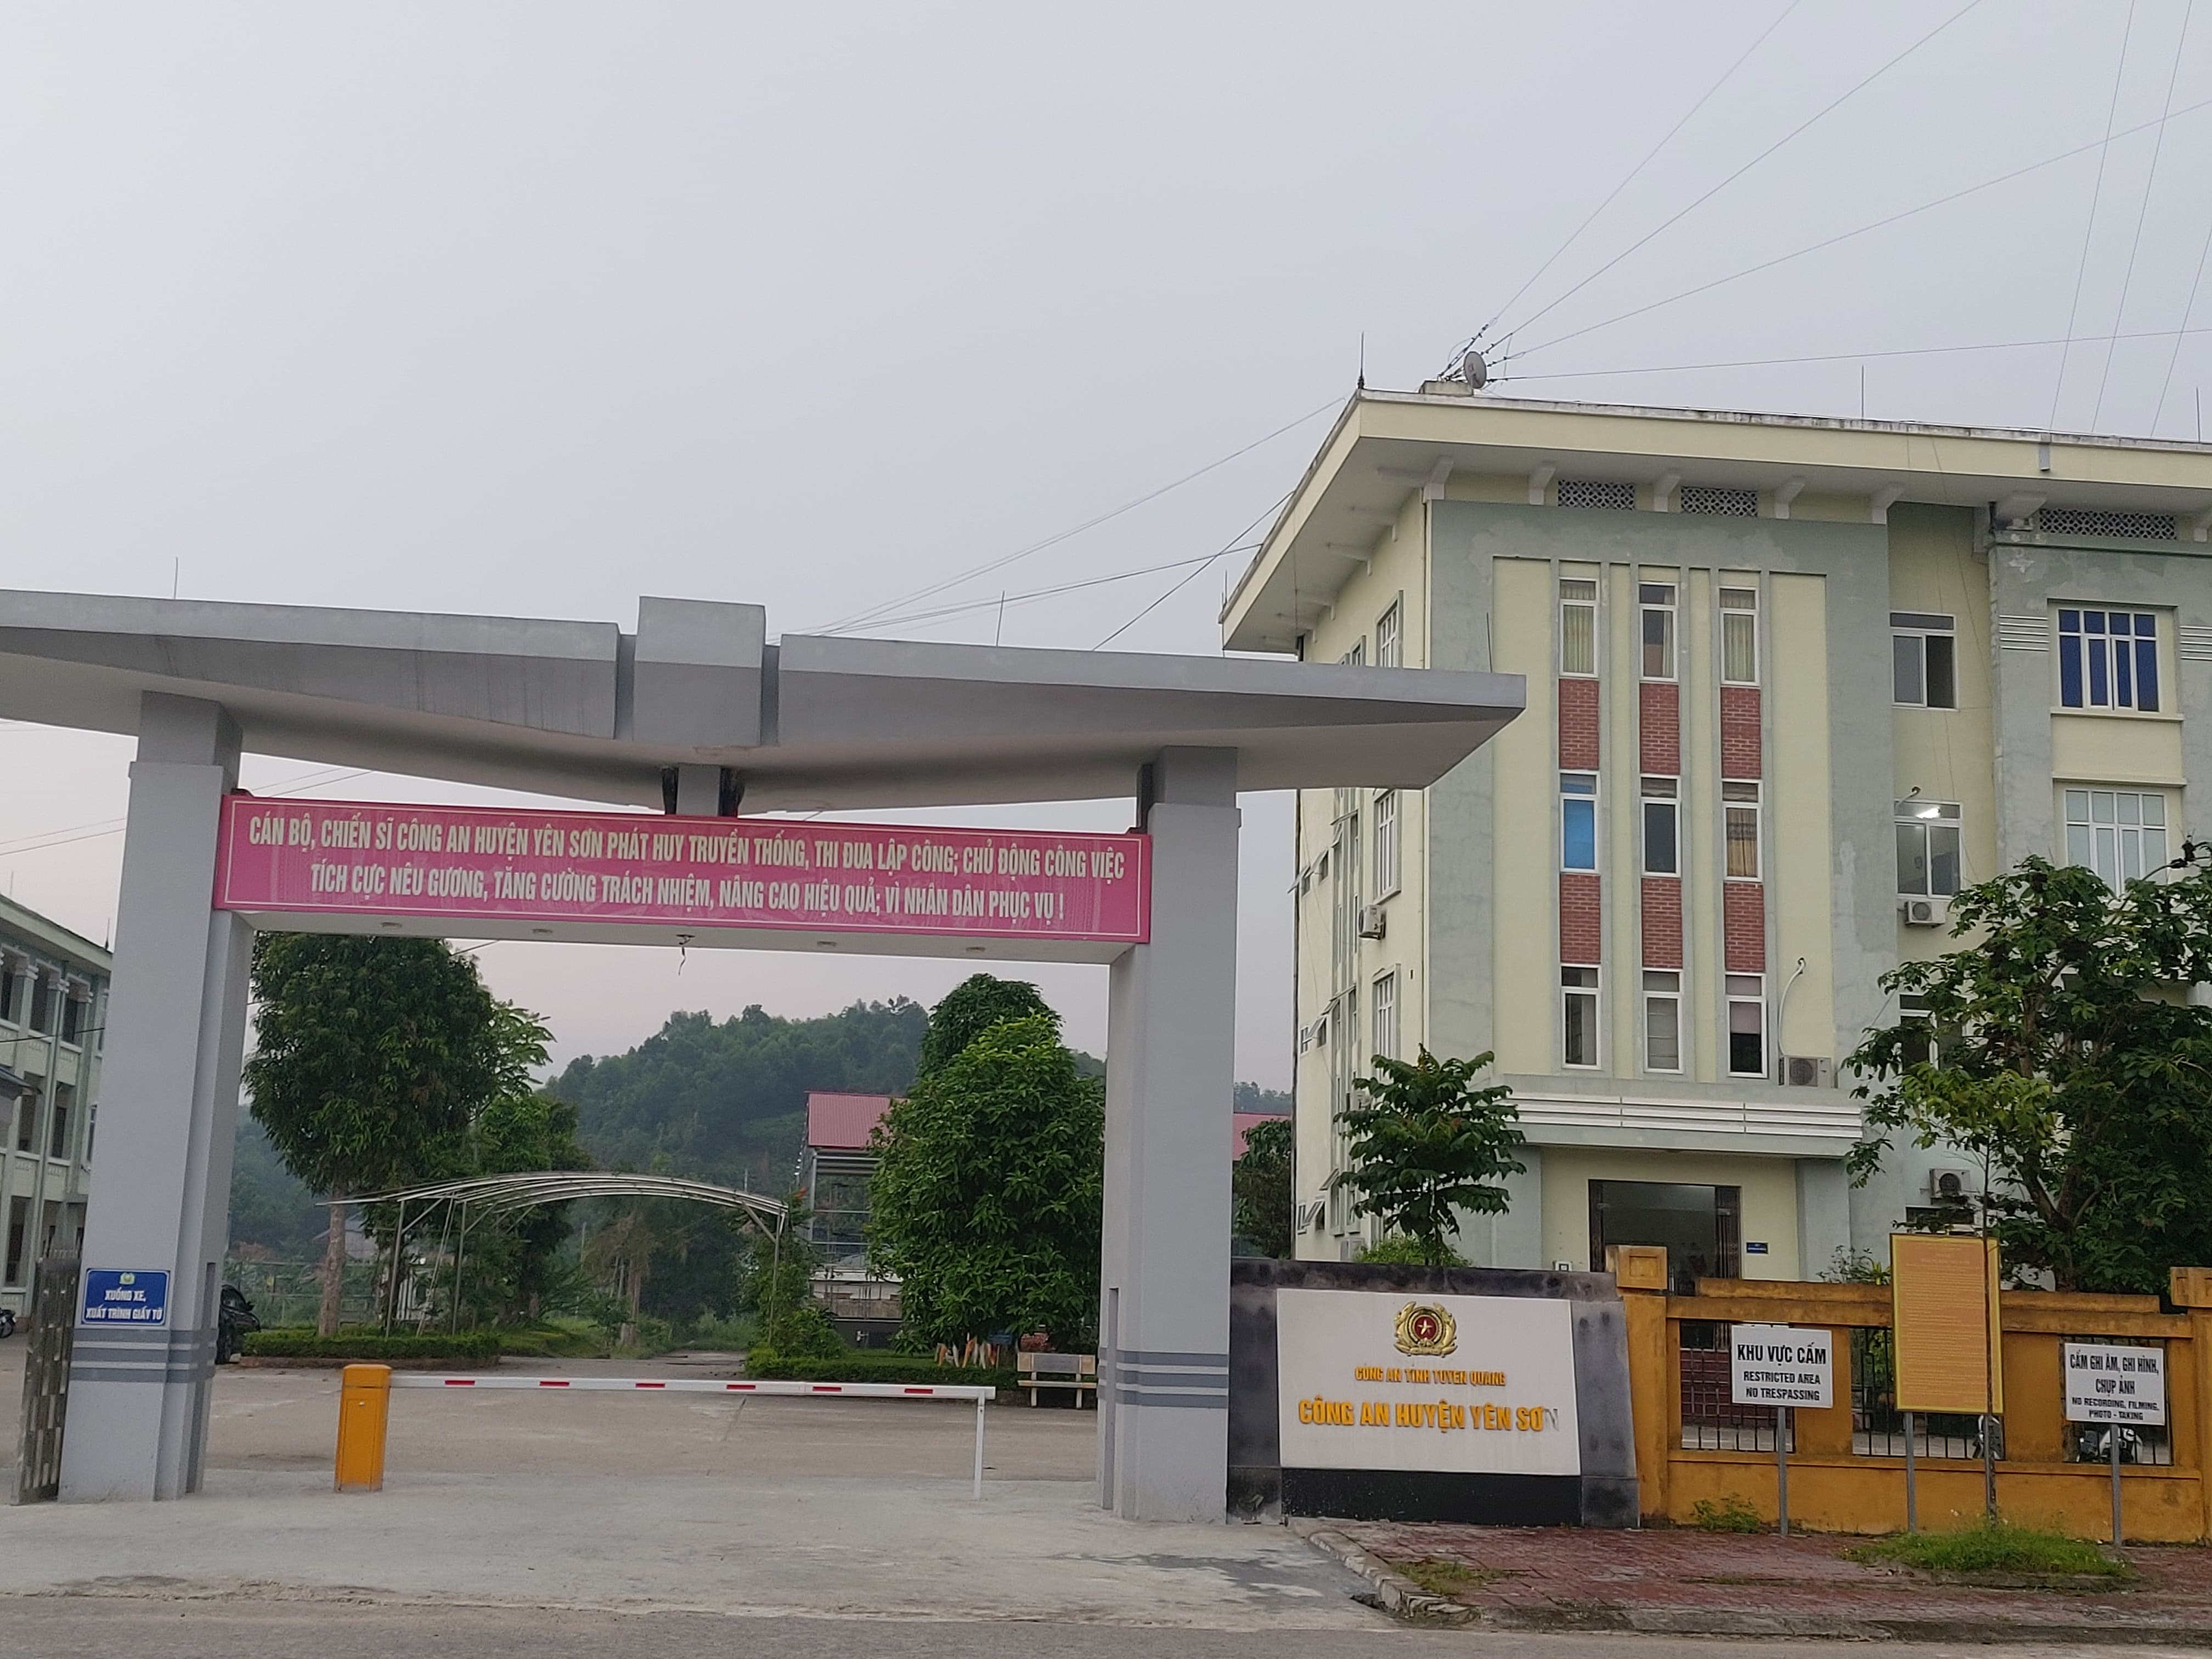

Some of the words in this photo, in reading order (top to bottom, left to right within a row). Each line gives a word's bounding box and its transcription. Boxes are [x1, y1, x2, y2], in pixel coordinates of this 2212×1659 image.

[250, 811, 284, 845] CÁN
[288, 812, 315, 852] BỘ,
[321, 812, 371, 849] CHIẾN
[375, 817, 394, 850] SĨ
[397, 818, 442, 852] CÔNG
[446, 825, 471, 853] AN
[474, 822, 529, 861] HUYỆN
[533, 823, 565, 857] YÊN
[569, 828, 603, 858] SƠN
[607, 827, 649, 860] PHÁT
[652, 833, 684, 862] HUY
[689, 828, 749, 865] TRUYỀN
[754, 830, 809, 871] THỐNG,
[815, 840, 839, 868] THI
[842, 842, 873, 870] ĐUA
[878, 838, 907, 876] LẬP
[911, 839, 958, 877] CÔNG;
[963, 838, 994, 874] CHỦ
[998, 843, 1040, 881] ĐỘNG
[1045, 844, 1086, 878] CÔNG
[1091, 847, 1125, 884] VIỆC
[311, 858, 348, 893] TÍCH
[352, 864, 385, 900] CỰC
[390, 862, 424, 896] NÊU
[427, 866, 488, 902] GƯƠNG,
[494, 866, 537, 901] TĂNG
[541, 867, 597, 902] CƯỜNG
[601, 870, 653, 905] TRÁCH
[657, 873, 714, 912] NHIỆM,
[719, 874, 764, 909] NÂNG
[769, 882, 800, 911] CAO
[804, 878, 840, 917] HIỆU
[844, 877, 881, 916] QUẢ;
[885, 881, 900, 913] VÌ
[905, 882, 948, 916] NHÂN
[952, 884, 984, 917] DÂN
[989, 890, 1030, 924] PHỤC
[1034, 892, 1054, 926] VỤ
[105, 1286, 132, 1301] XUỐNG
[86, 1304, 107, 1319] XUẤT
[132, 1306, 151, 1320] GIẤY
[1737, 1344, 1763, 1361] KHU
[1768, 1345, 1792, 1366] VỰC
[1797, 1342, 1826, 1364] CẤM
[2070, 1350, 2088, 1369] CẤM
[2090, 1355, 2103, 1370] GHI
[2123, 1357, 2136, 1372] GHI
[2137, 1355, 2159, 1376] HÌNH,
[1386, 1367, 1402, 1383] AN
[1470, 1370, 1506, 1386] QUANG
[1743, 1371, 1795, 1383] RESTRICTED
[1797, 1373, 1821, 1385] AREA
[2095, 1378, 2117, 1397] CHỤP
[2119, 1374, 2135, 1395] ẢNH
[1746, 1387, 1758, 1398] NO
[1760, 1387, 1820, 1401] TRESPASSING
[2072, 1397, 2082, 1405] NO
[1299, 1395, 1355, 1425] CÔNG
[1360, 1401, 1389, 1427] AN
[1396, 1398, 1465, 1433] HUYỆN
[1470, 1402, 1511, 1431] YÊN
[2089, 1409, 2112, 1419] PHOTO
